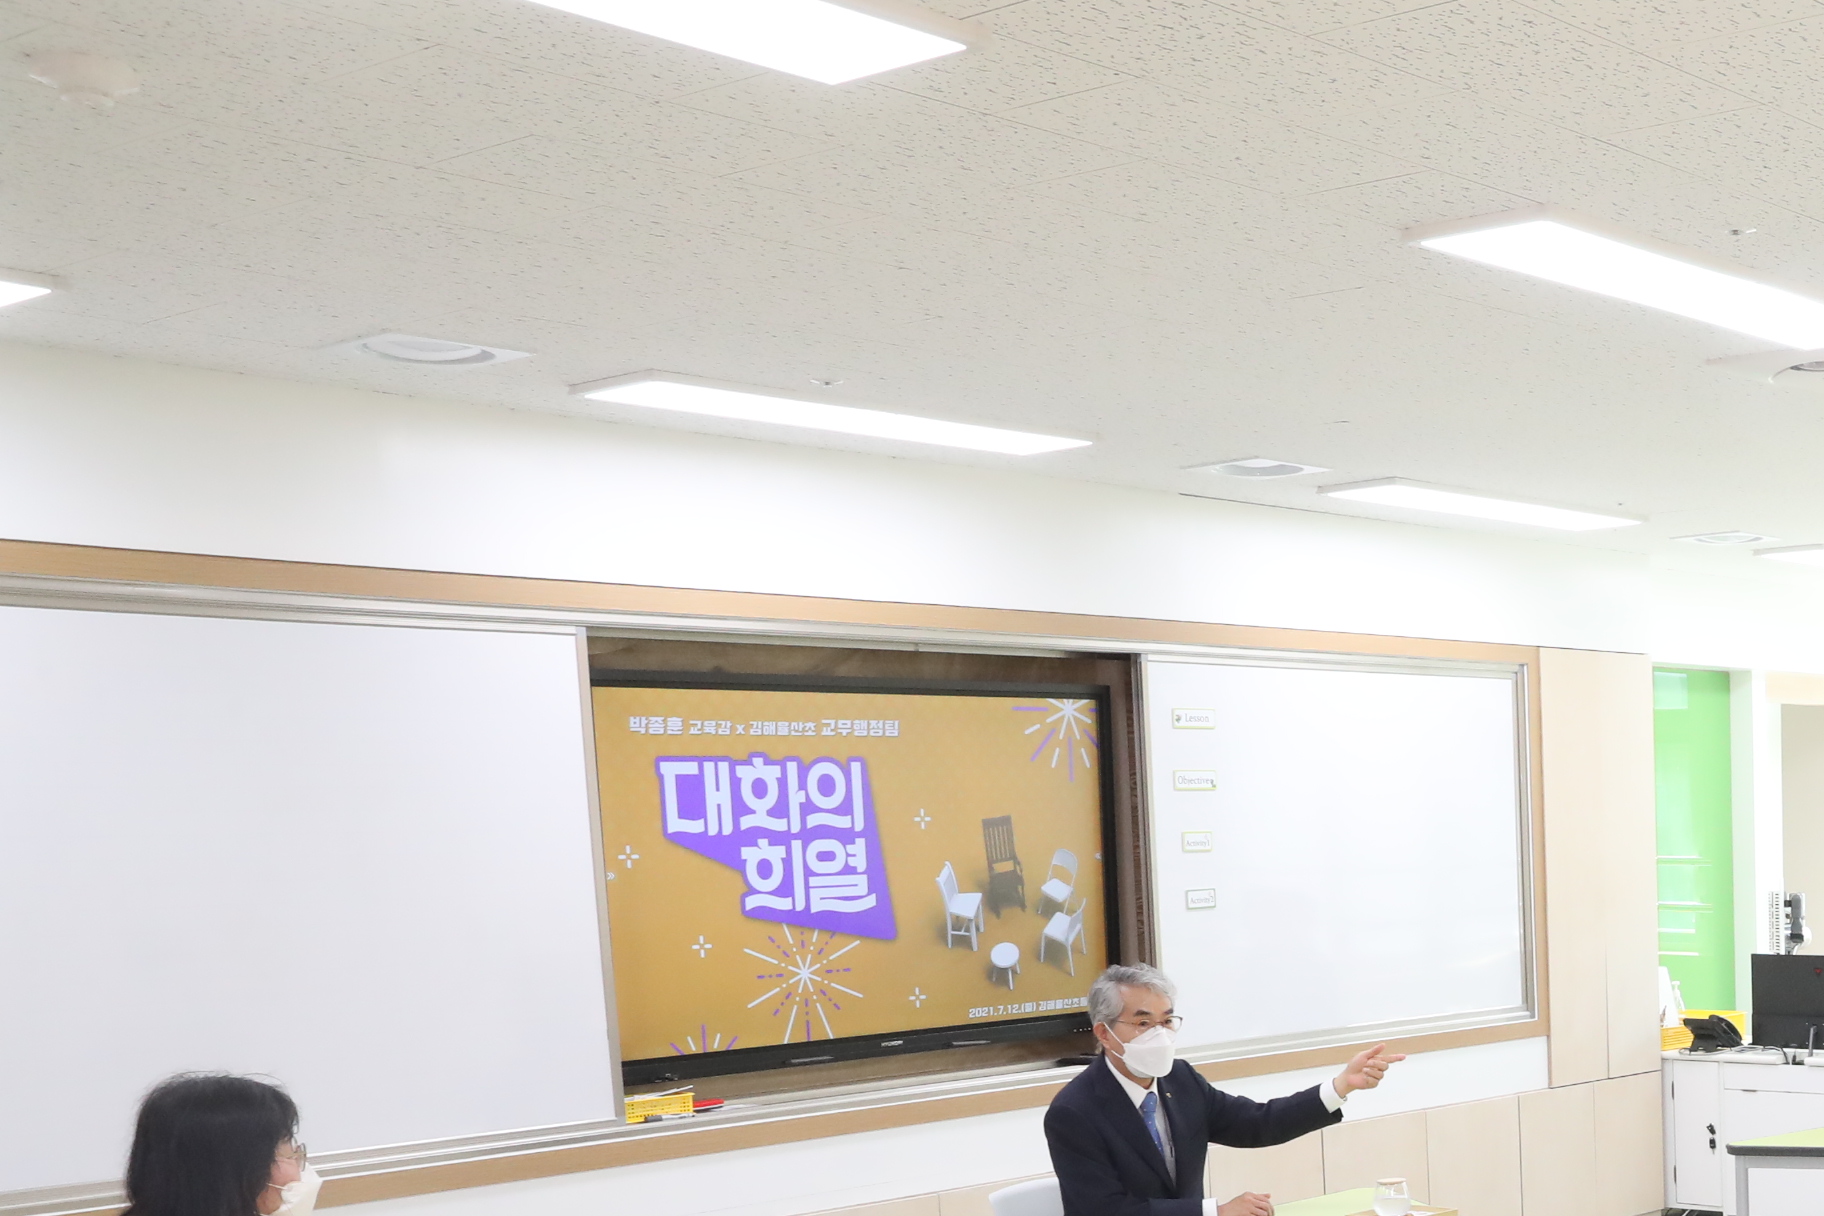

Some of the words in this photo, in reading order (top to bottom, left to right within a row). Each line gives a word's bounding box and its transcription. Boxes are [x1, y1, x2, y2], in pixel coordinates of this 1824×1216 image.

[629, 716, 683, 735] 박종훈
[688, 720, 732, 735] 교육감
[821, 719, 899, 737] 교무행정팀
[1185, 713, 1210, 723] Lesson
[659, 757, 865, 836] 대화의
[740, 838, 876, 913] 희열
